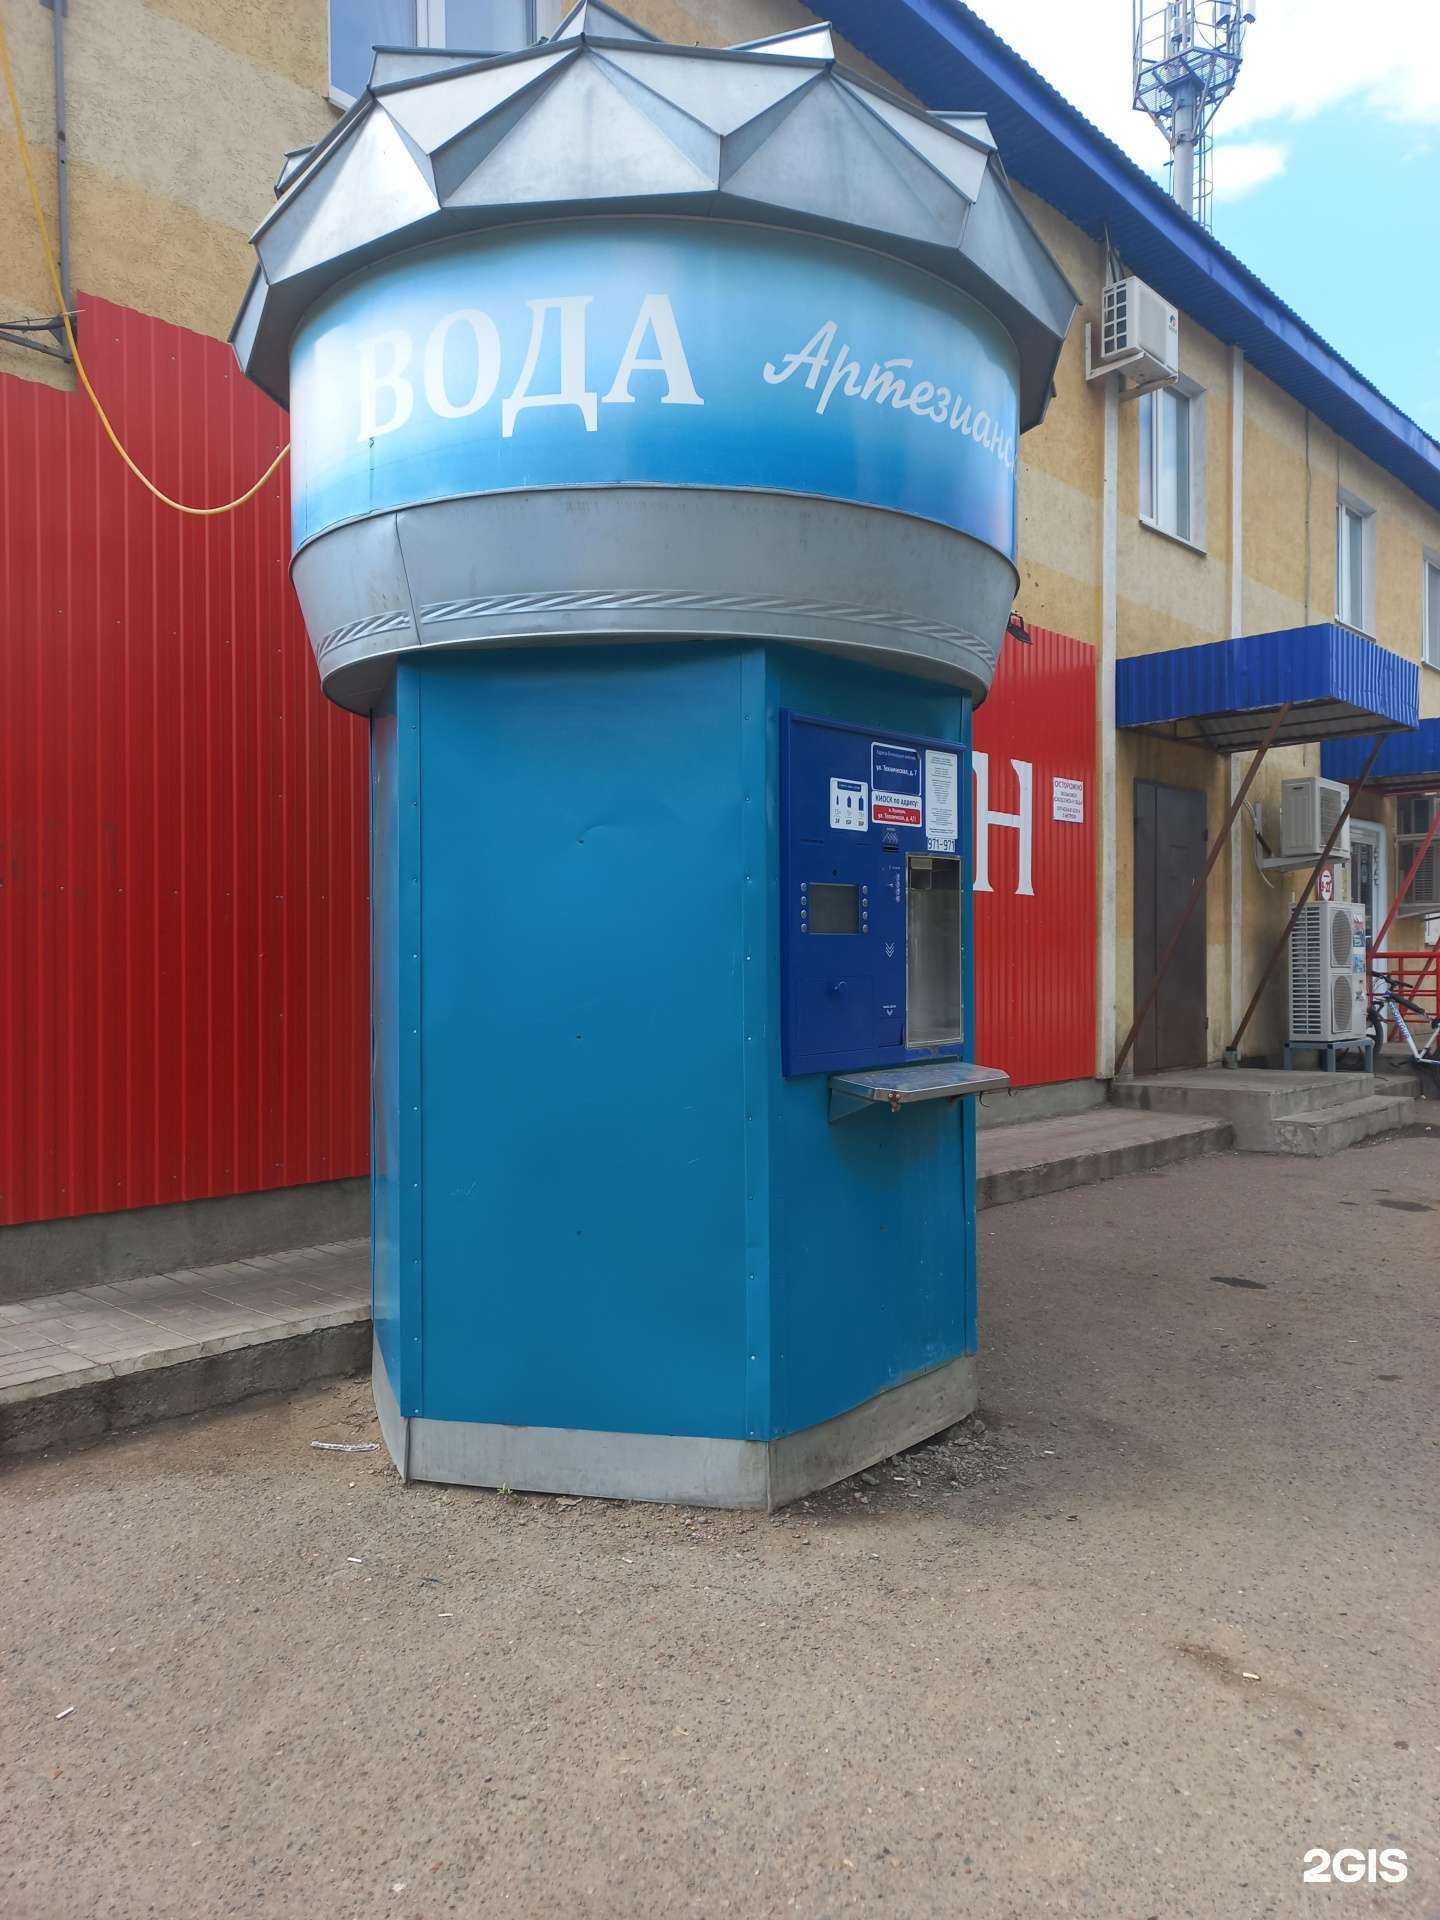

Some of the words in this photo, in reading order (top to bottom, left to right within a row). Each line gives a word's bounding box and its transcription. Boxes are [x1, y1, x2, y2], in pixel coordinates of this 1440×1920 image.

[356, 293, 705, 442] ВОДА
[763, 319, 1015, 472] Артезианс
[927, 838, 955, 851] 971-971
